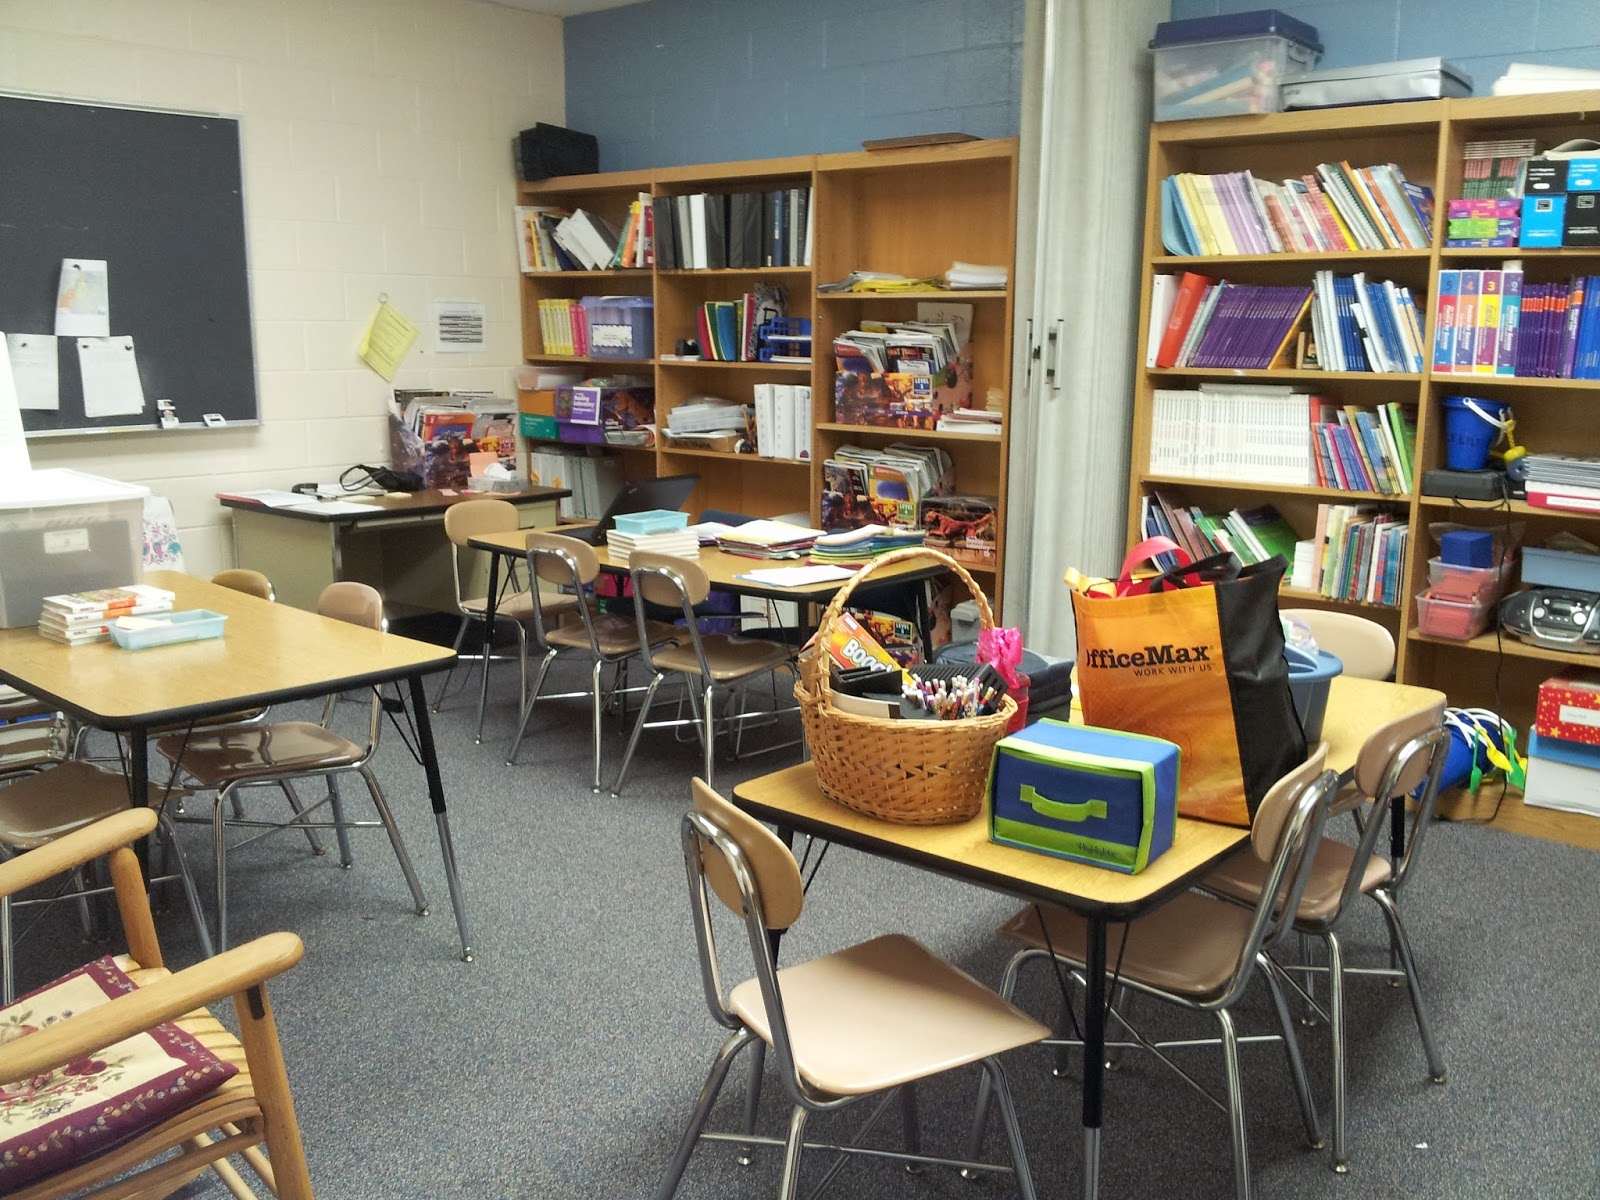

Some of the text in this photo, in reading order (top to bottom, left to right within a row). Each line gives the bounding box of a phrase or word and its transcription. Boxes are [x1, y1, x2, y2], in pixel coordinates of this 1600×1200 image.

[1487, 280, 1496, 292] 3
[1511, 281, 1518, 292] 2
[895, 622, 910, 630] LEVEL
[1134, 664, 1212, 677] WORK WITH US
